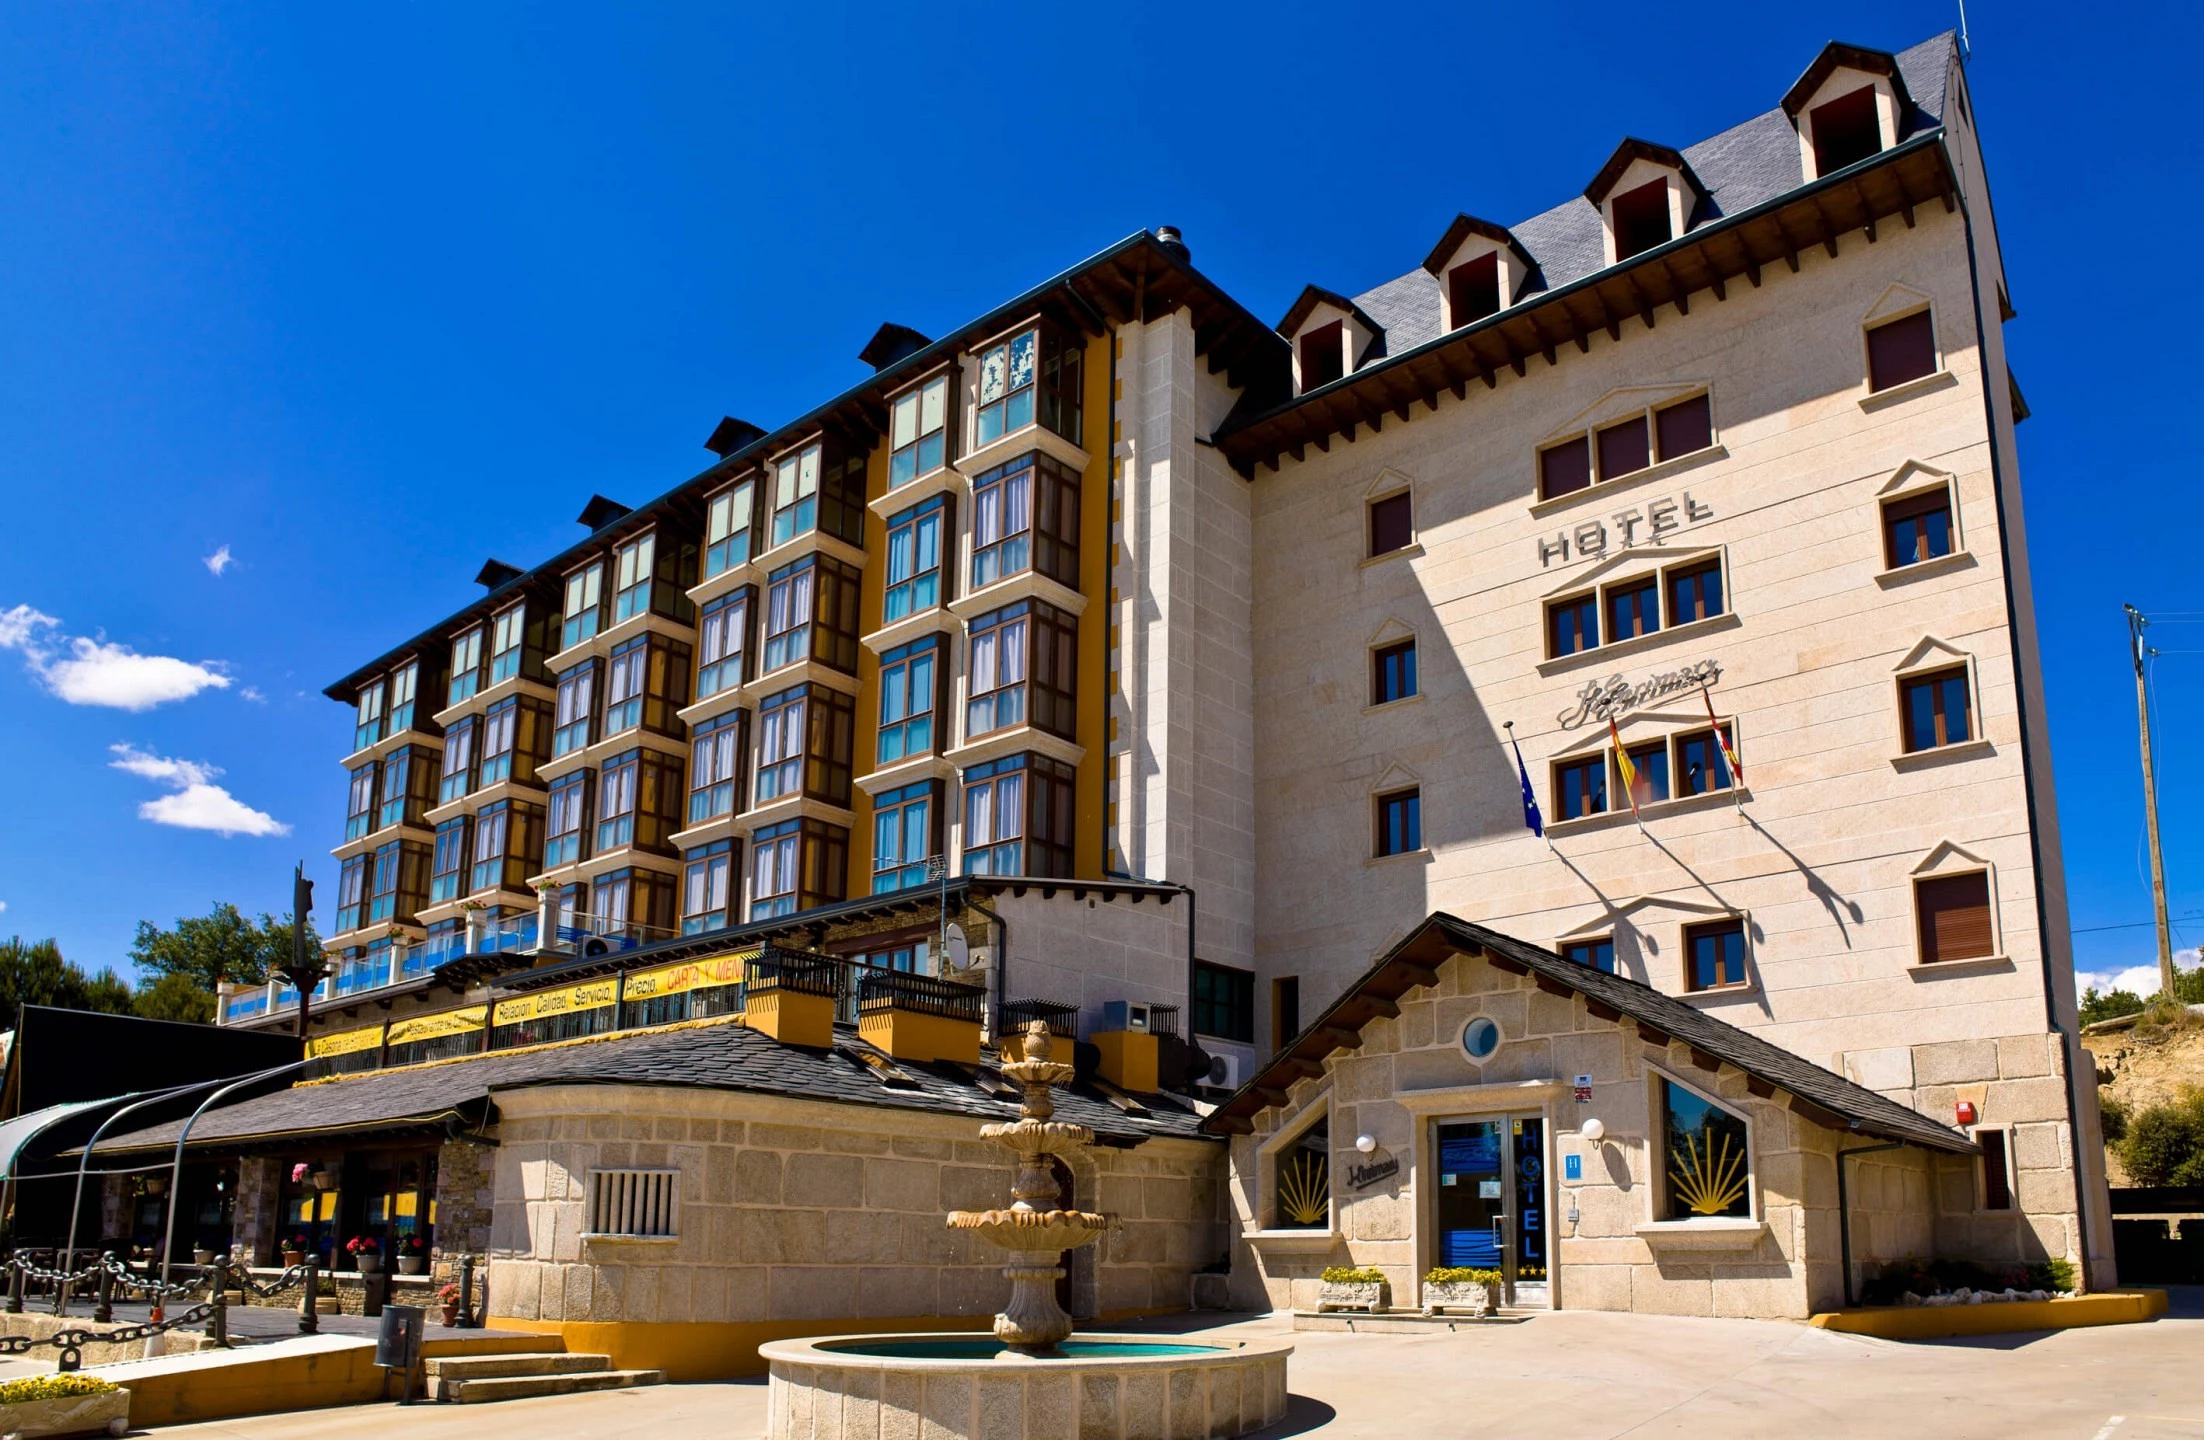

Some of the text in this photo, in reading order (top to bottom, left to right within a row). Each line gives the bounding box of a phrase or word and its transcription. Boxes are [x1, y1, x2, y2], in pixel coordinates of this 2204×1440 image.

[1538, 491, 1713, 567] HOTEL
[667, 964, 699, 990] CARTA
[704, 963, 712, 983] Y
[499, 1000, 531, 1021] Relación
[1521, 1127, 1541, 1259] HOTEL
